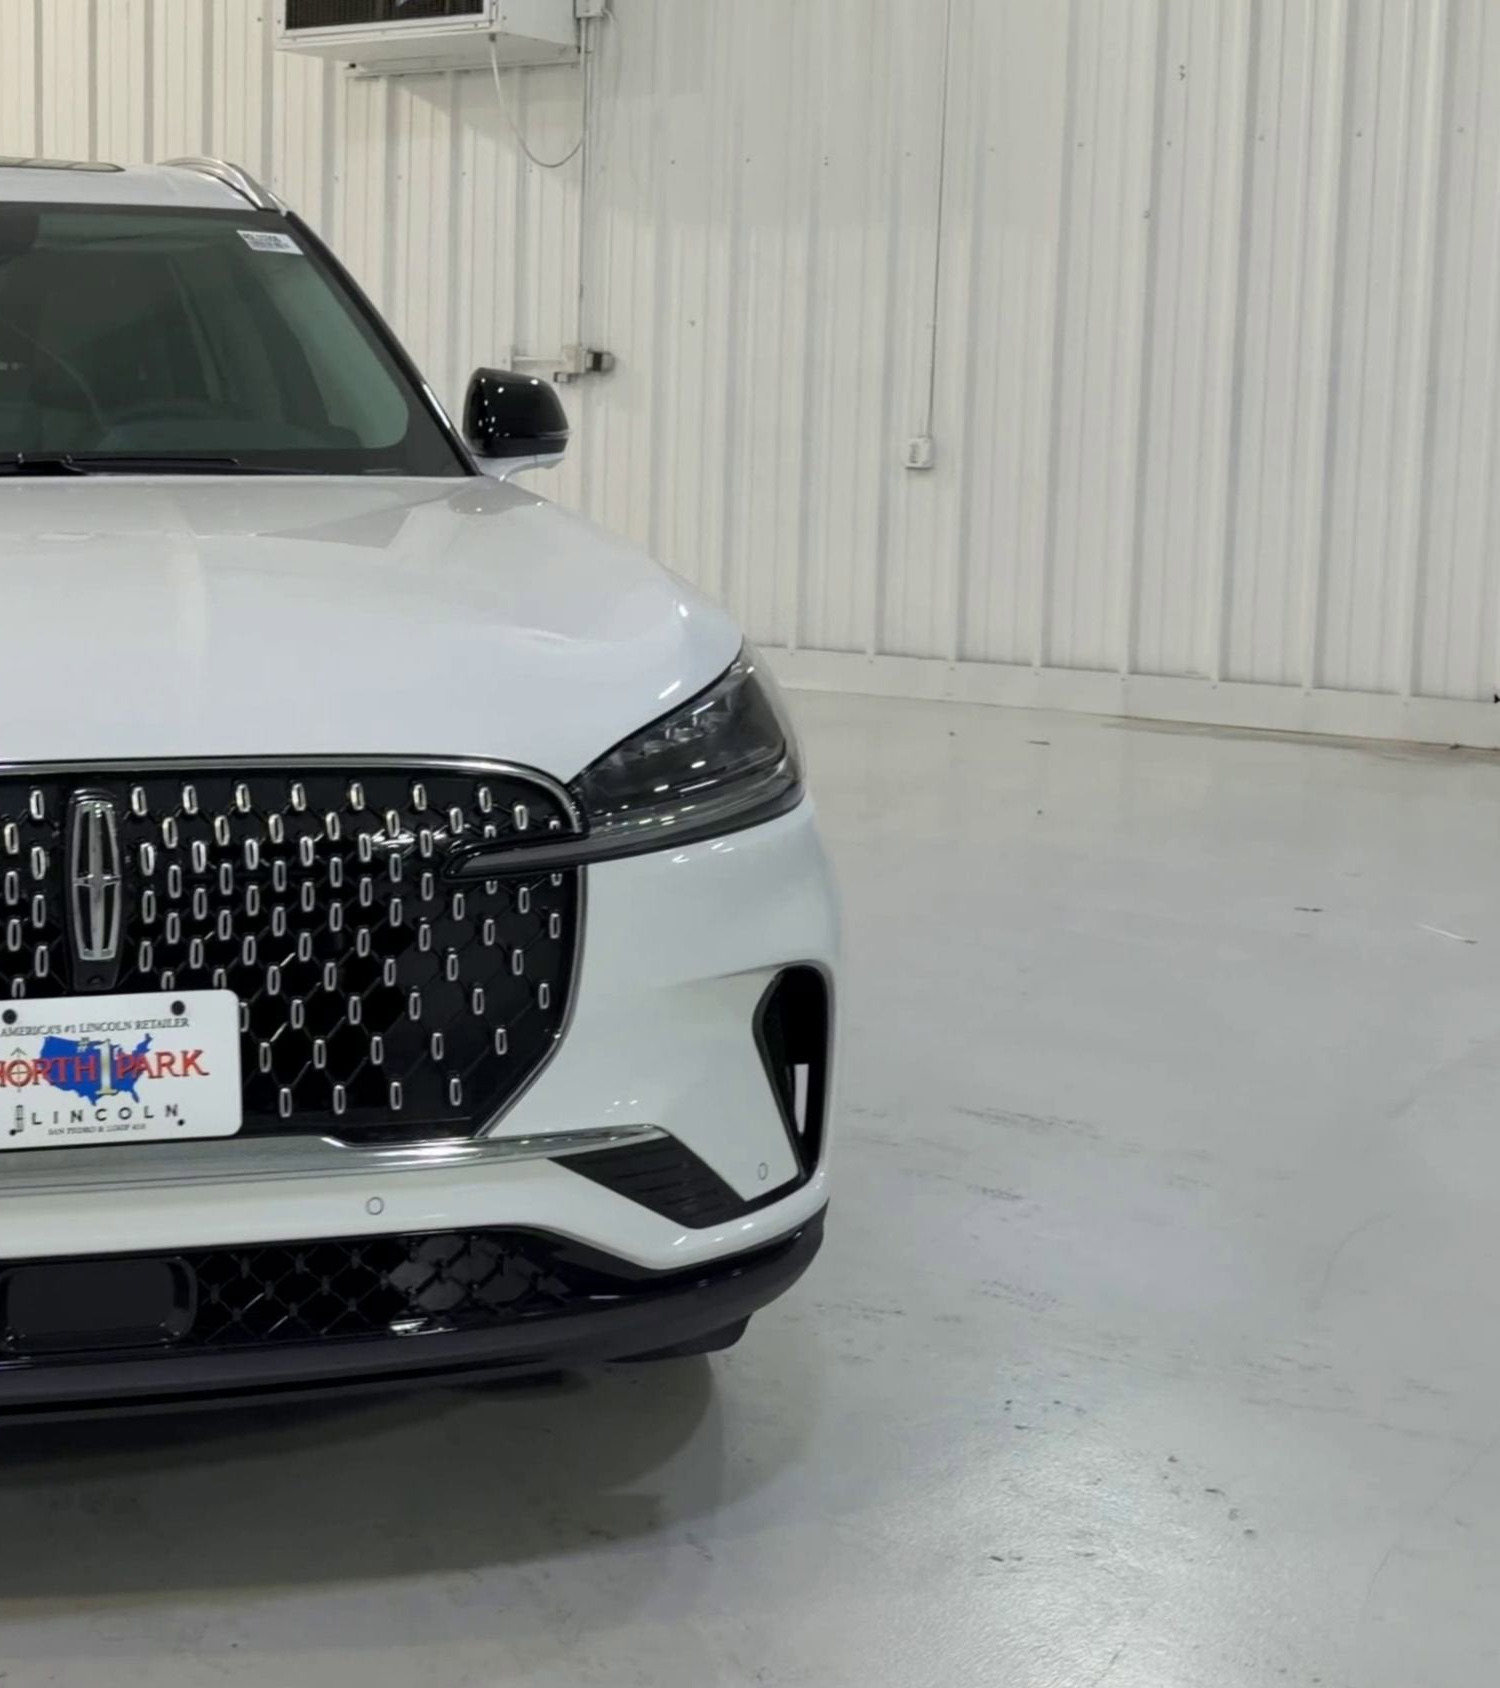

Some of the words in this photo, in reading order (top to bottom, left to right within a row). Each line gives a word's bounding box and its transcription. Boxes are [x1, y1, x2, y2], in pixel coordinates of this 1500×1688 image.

[0, 1025, 61, 1037] AMERICA'S
[79, 1022, 132, 1033] LINCOLN
[135, 1018, 189, 1030] RETAILER
[116, 1050, 210, 1079] PARK
[31, 1104, 179, 1126] LINCOLN
